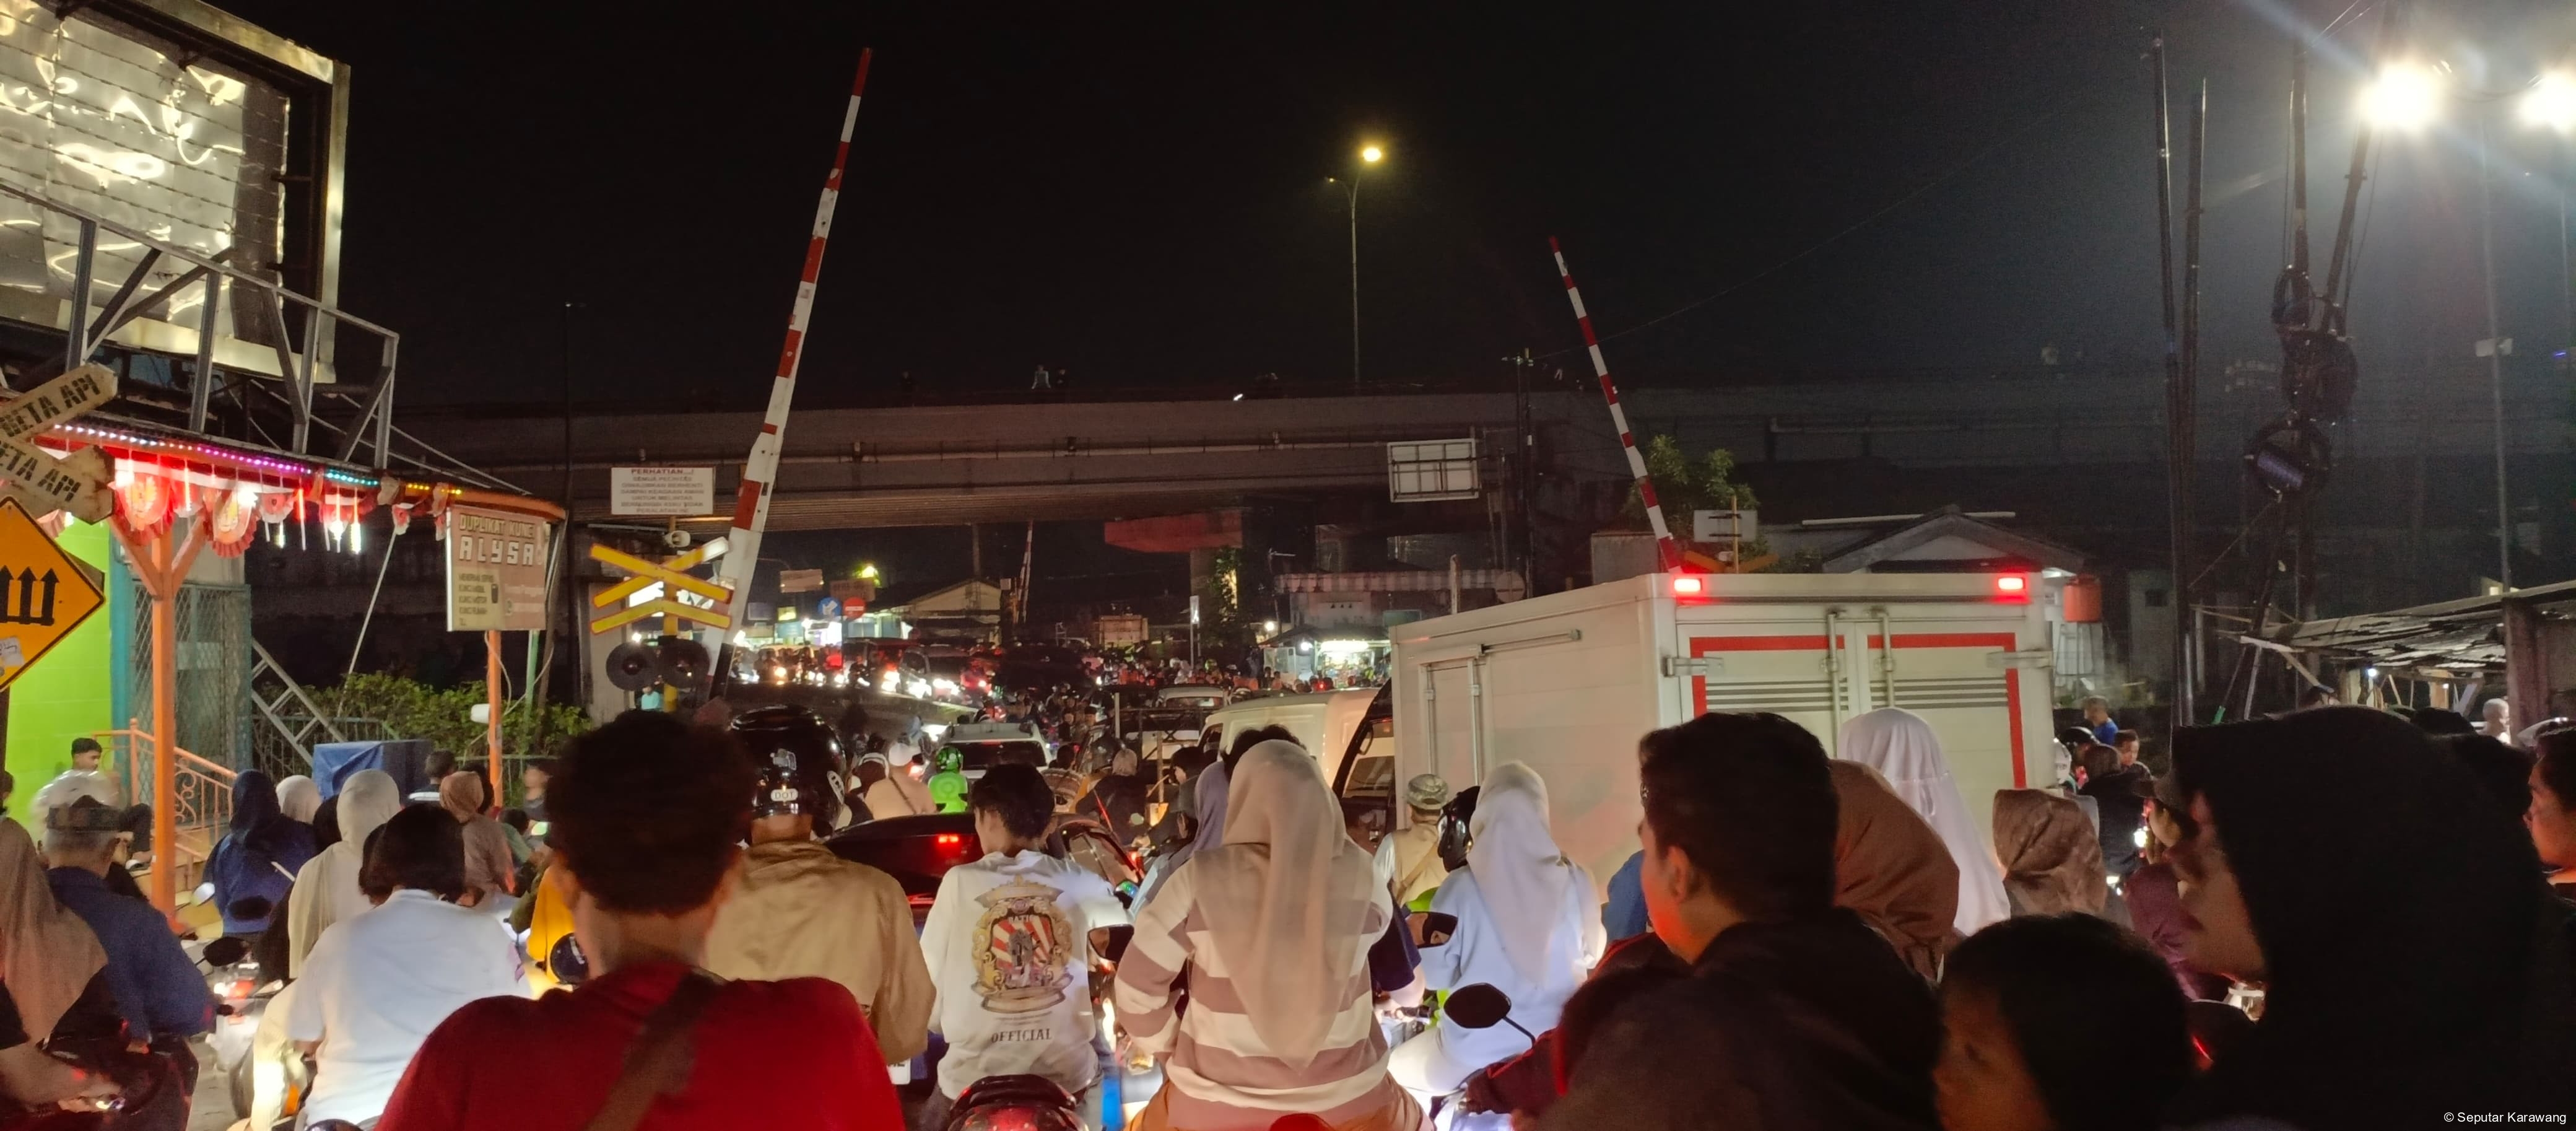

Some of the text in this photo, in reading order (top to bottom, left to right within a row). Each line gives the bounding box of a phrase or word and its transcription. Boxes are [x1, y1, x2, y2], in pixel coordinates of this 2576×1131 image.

[60, 373, 100, 409] API
[37, 468, 81, 502] API
[459, 513, 505, 536] DUPLIKAT
[459, 535, 534, 567] ALYSA
[991, 1028, 1052, 1044] OFFICIAL
